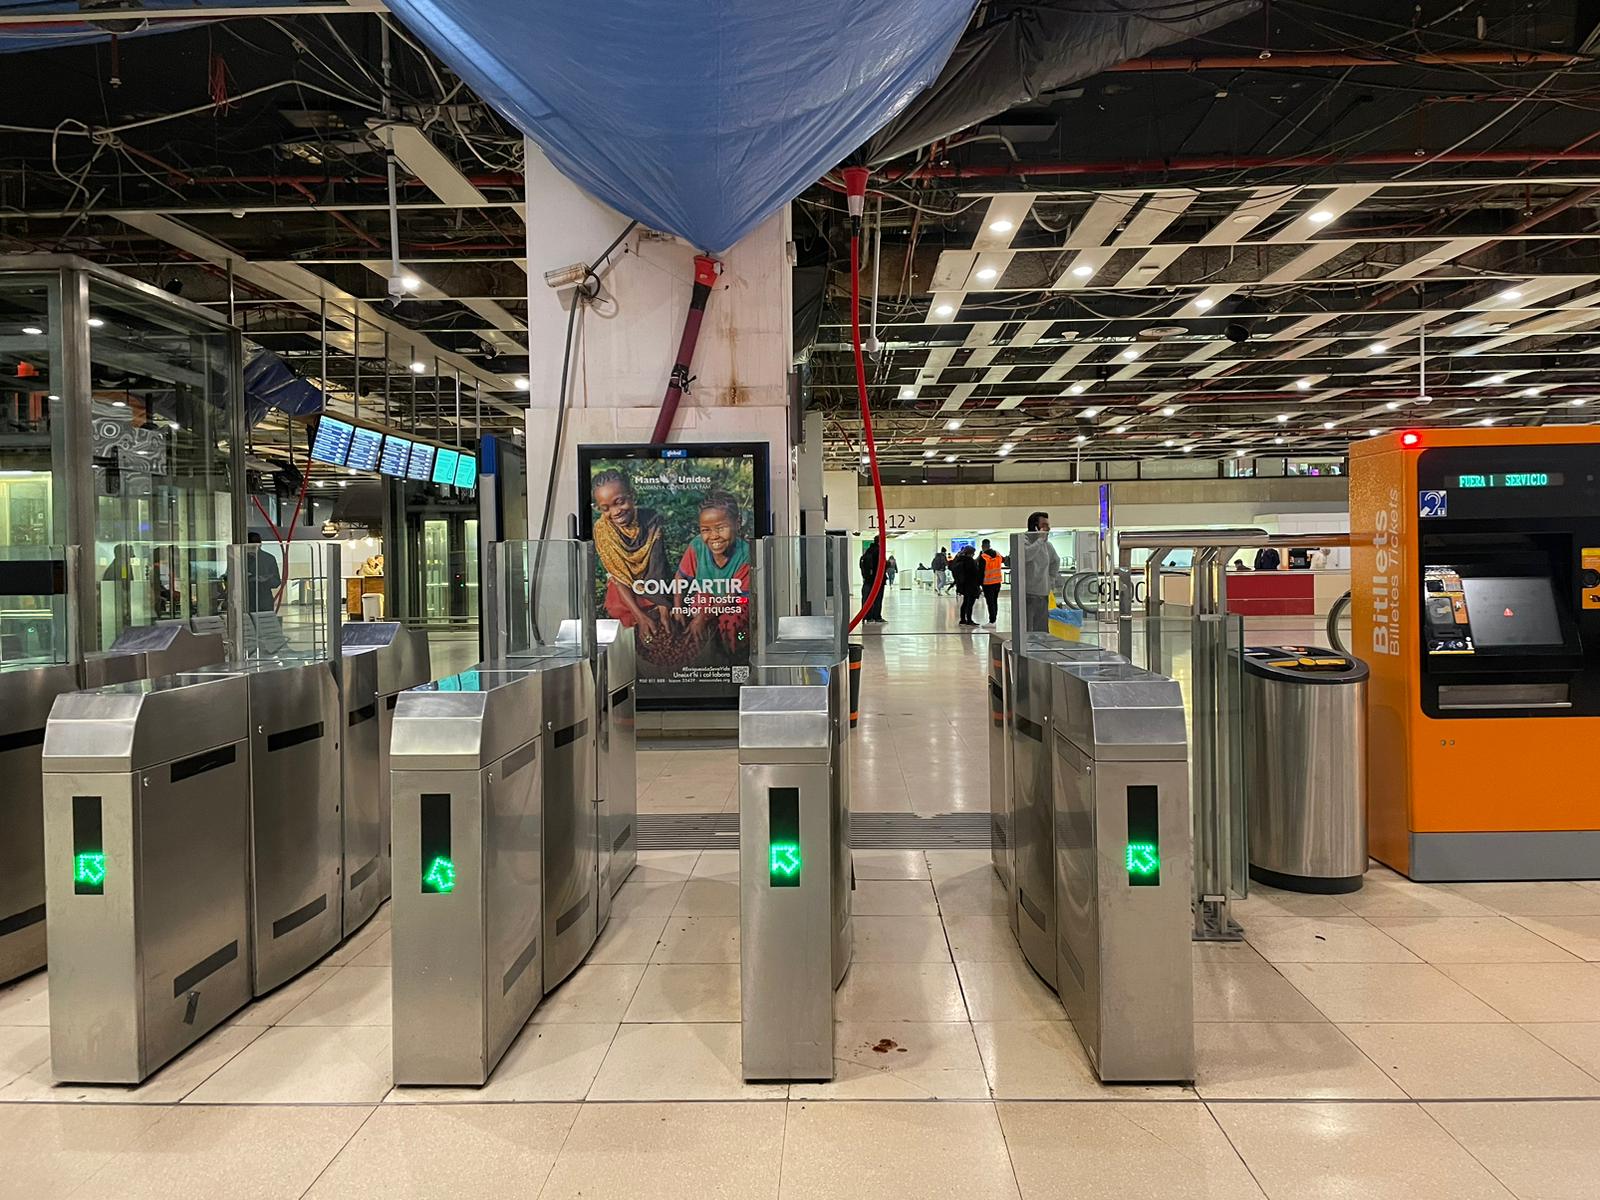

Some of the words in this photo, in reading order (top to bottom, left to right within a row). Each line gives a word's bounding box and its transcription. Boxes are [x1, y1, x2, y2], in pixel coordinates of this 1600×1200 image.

[635, 475, 660, 484] Mans
[678, 475, 711, 484] Unides
[1459, 475, 1486, 488] FUERA
[1505, 473, 1548, 487] SERVICIO
[1388, 489, 1399, 567] Tickets
[632, 578, 742, 594] COMPARTIR
[1373, 510, 1389, 654] Billets
[684, 594, 695, 604] és
[697, 594, 706, 604] la
[709, 594, 742, 604] nostra
[671, 604, 701, 616] major
[704, 604, 742, 616] riquesa
[1389, 575, 1400, 656] Billetes
